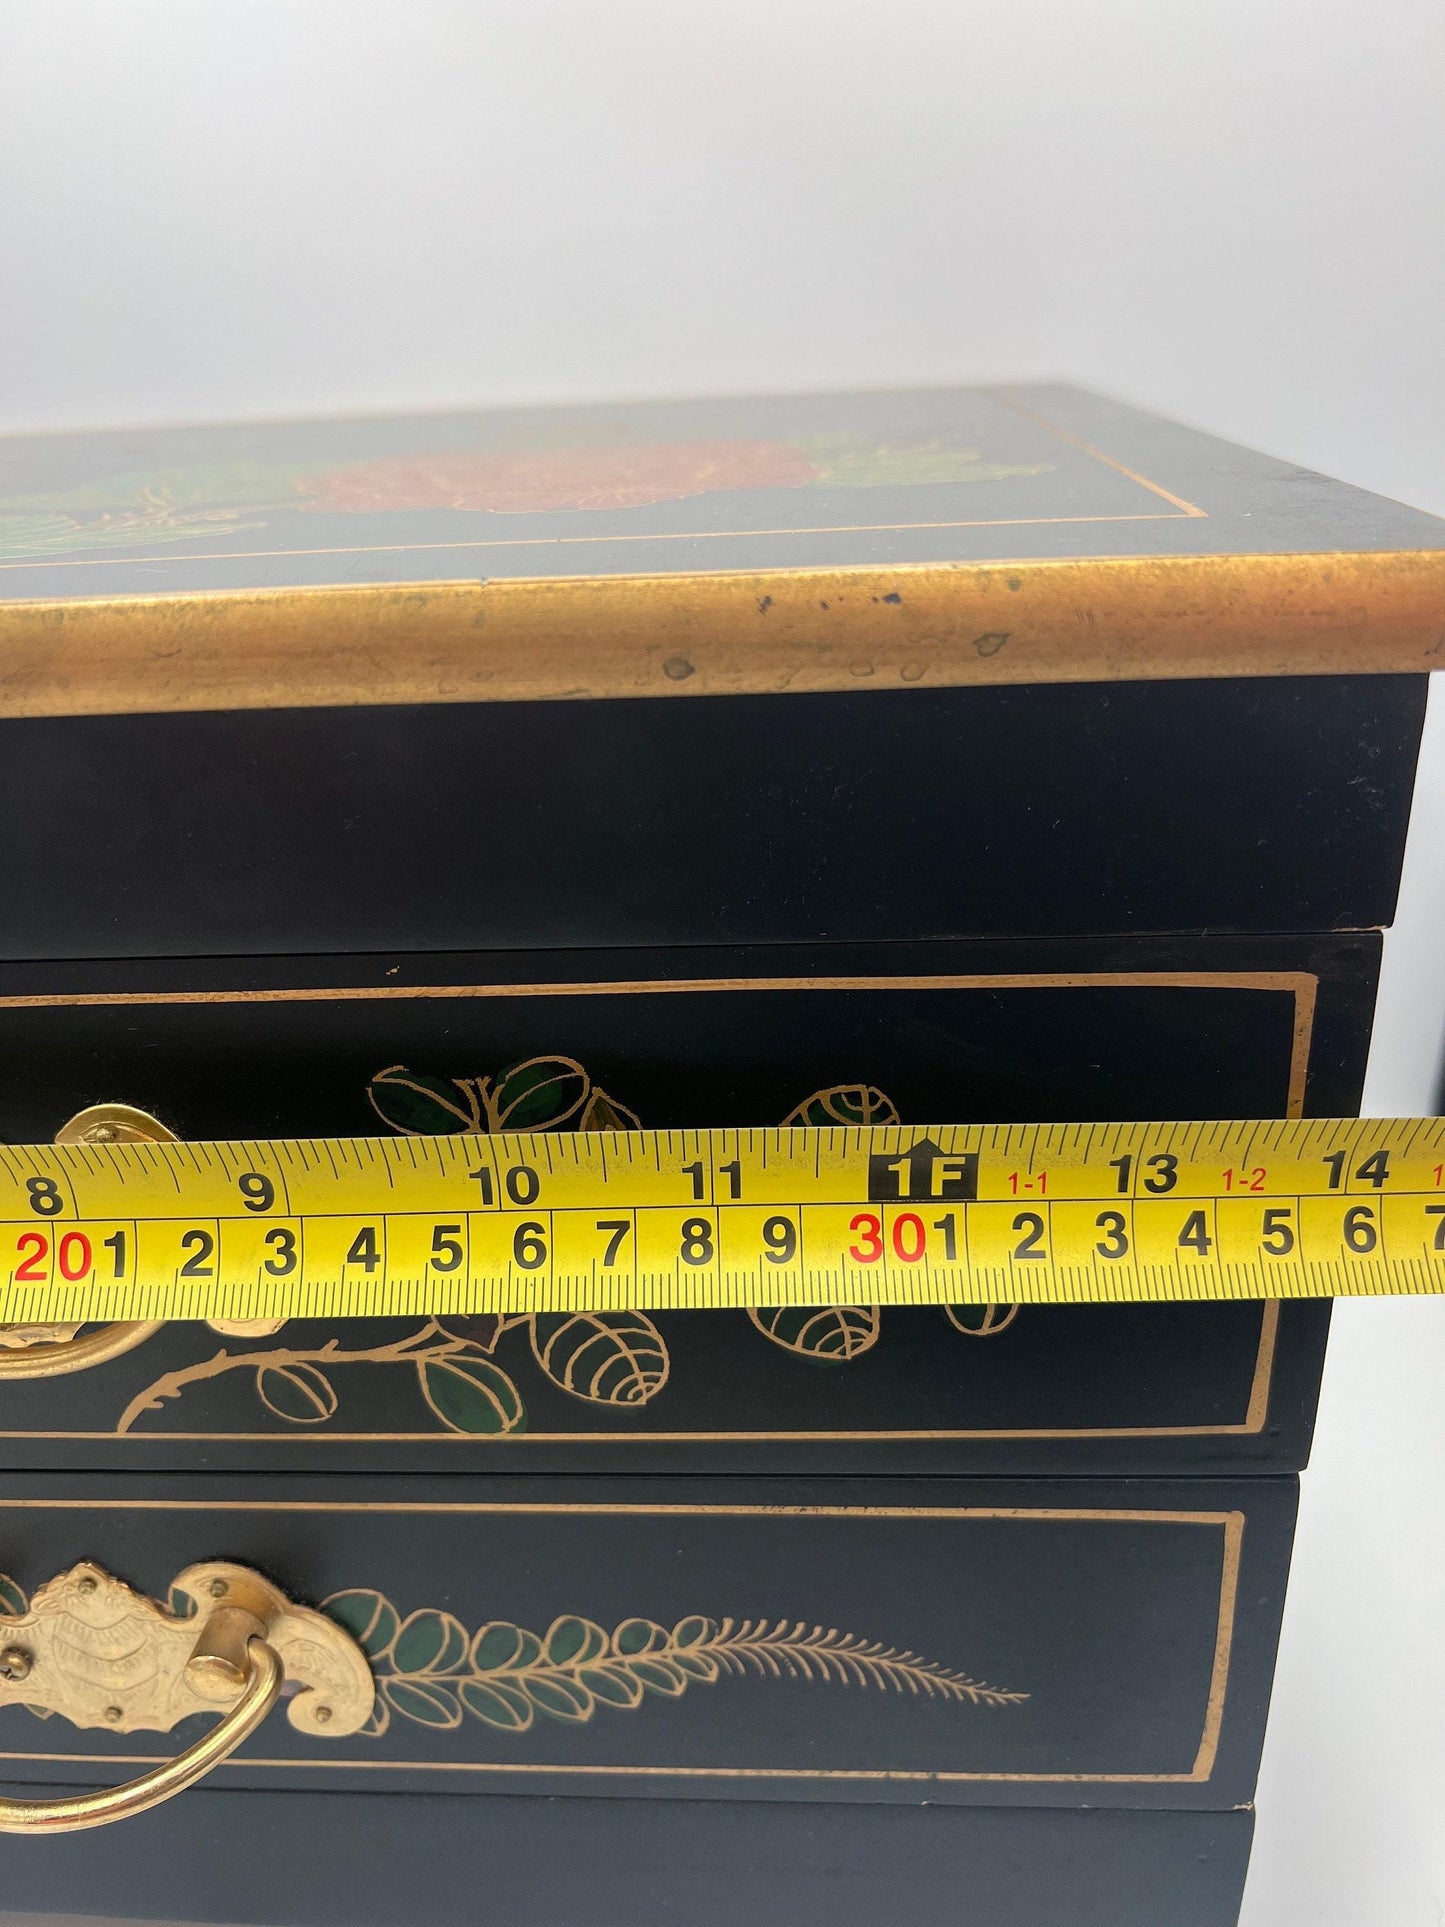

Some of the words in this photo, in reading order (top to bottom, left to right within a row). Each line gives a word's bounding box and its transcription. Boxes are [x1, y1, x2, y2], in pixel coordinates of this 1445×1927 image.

[26, 1177, 63, 1216] 8
[238, 1172, 275, 1212] 9
[470, 1166, 540, 1205] 10
[682, 1161, 741, 1200] 11
[1008, 1171, 1047, 1195] 1-1
[1109, 1154, 1178, 1193] 13
[1222, 1168, 1266, 1191] 1-2
[1322, 1150, 1389, 1189] 14
[15, 1232, 92, 1281] 20
[104, 1231, 125, 1277] 1
[181, 1230, 213, 1277] 2
[264, 1229, 297, 1276] 3
[347, 1227, 380, 1273] 4
[430, 1225, 463, 1272] 5
[513, 1222, 546, 1269] 6
[596, 1221, 630, 1267] 7
[680, 1218, 713, 1266] 8
[762, 1216, 796, 1264] 9
[849, 1213, 925, 1262] 30
[934, 1213, 955, 1260] 1
[1012, 1212, 1046, 1259] 2
[1095, 1211, 1128, 1259] 3
[1178, 1210, 1211, 1256] 4
[1262, 1209, 1293, 1255] 5
[1343, 1206, 1377, 1253] 6
